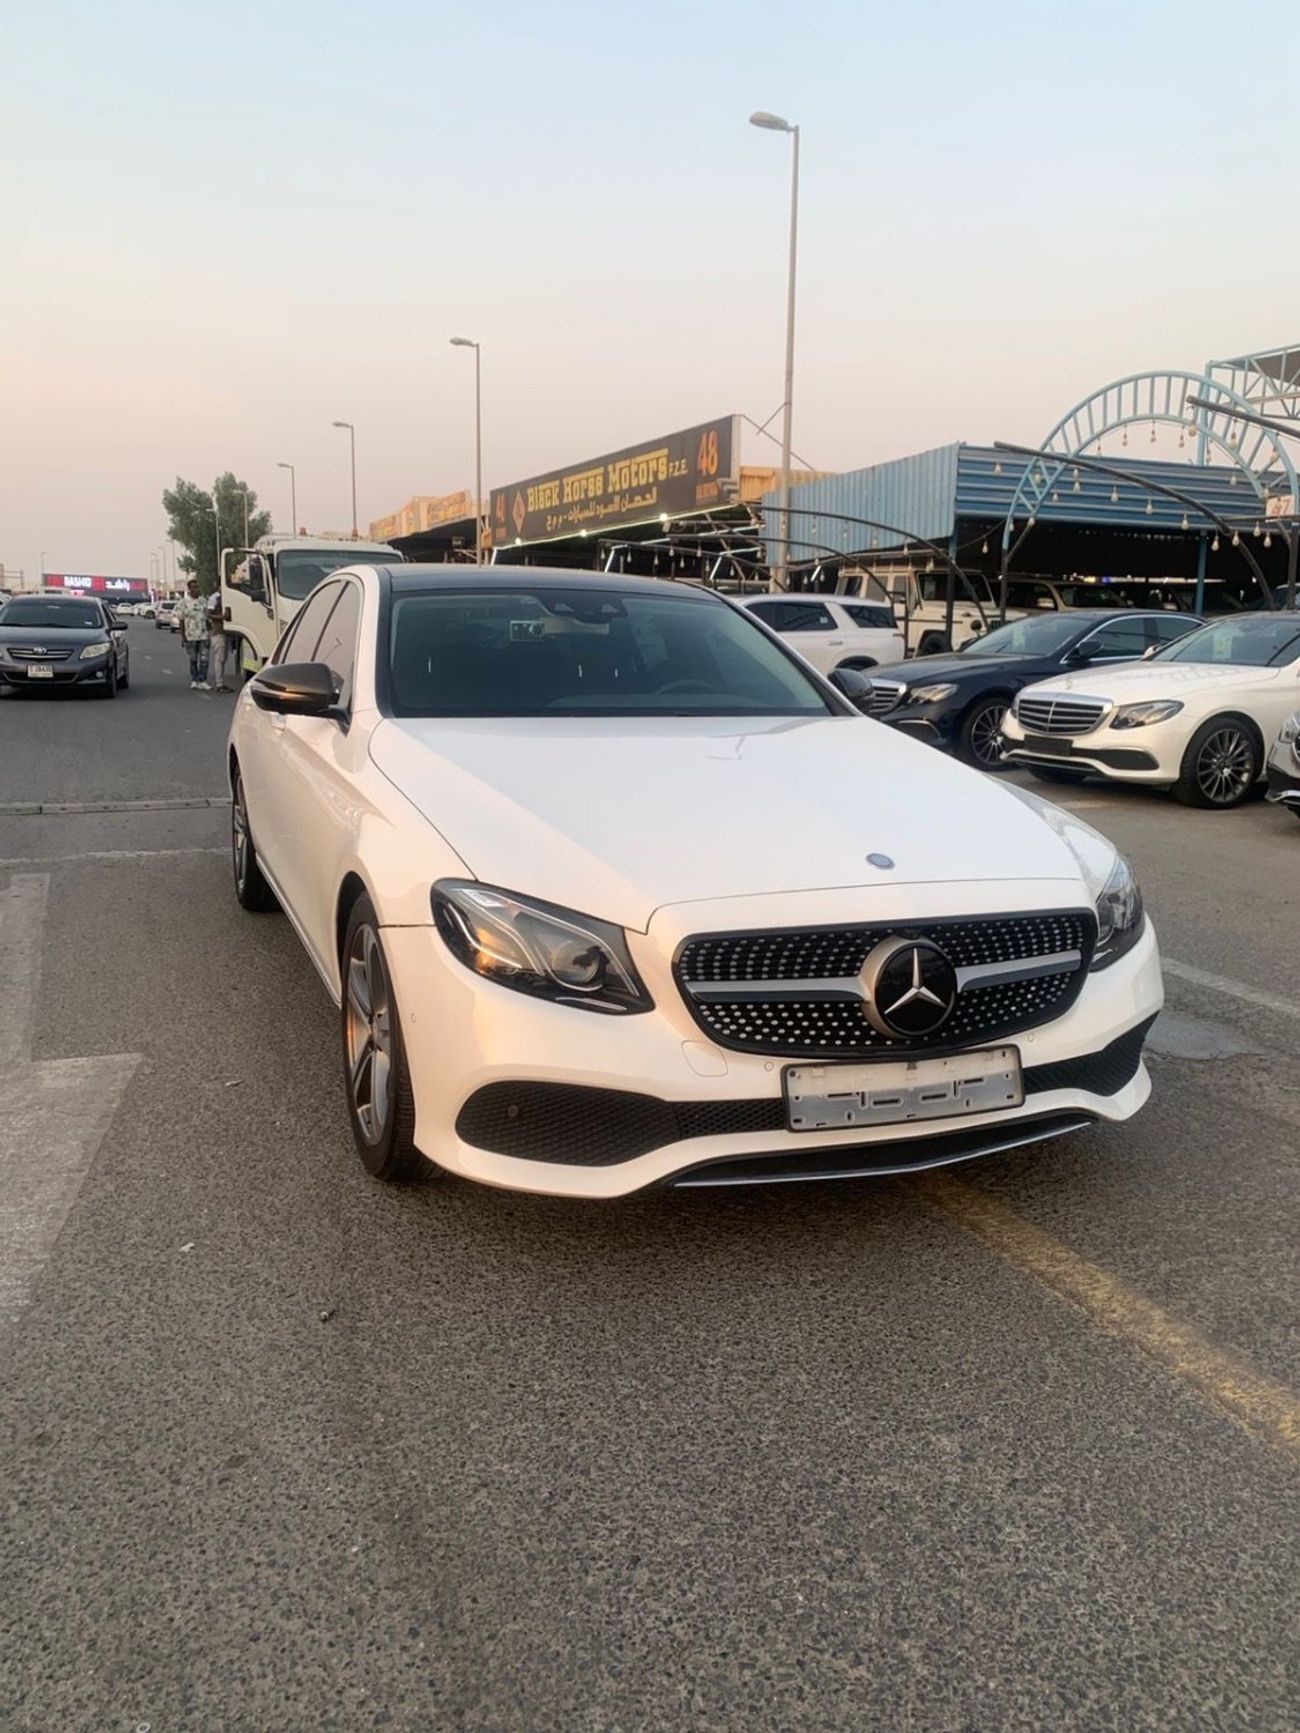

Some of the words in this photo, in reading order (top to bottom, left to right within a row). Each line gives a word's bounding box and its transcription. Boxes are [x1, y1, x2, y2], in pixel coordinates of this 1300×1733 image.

[527, 480, 560, 512] Black
[562, 466, 604, 503] Horse
[607, 448, 668, 493] Motors
[697, 430, 718, 476] 48
